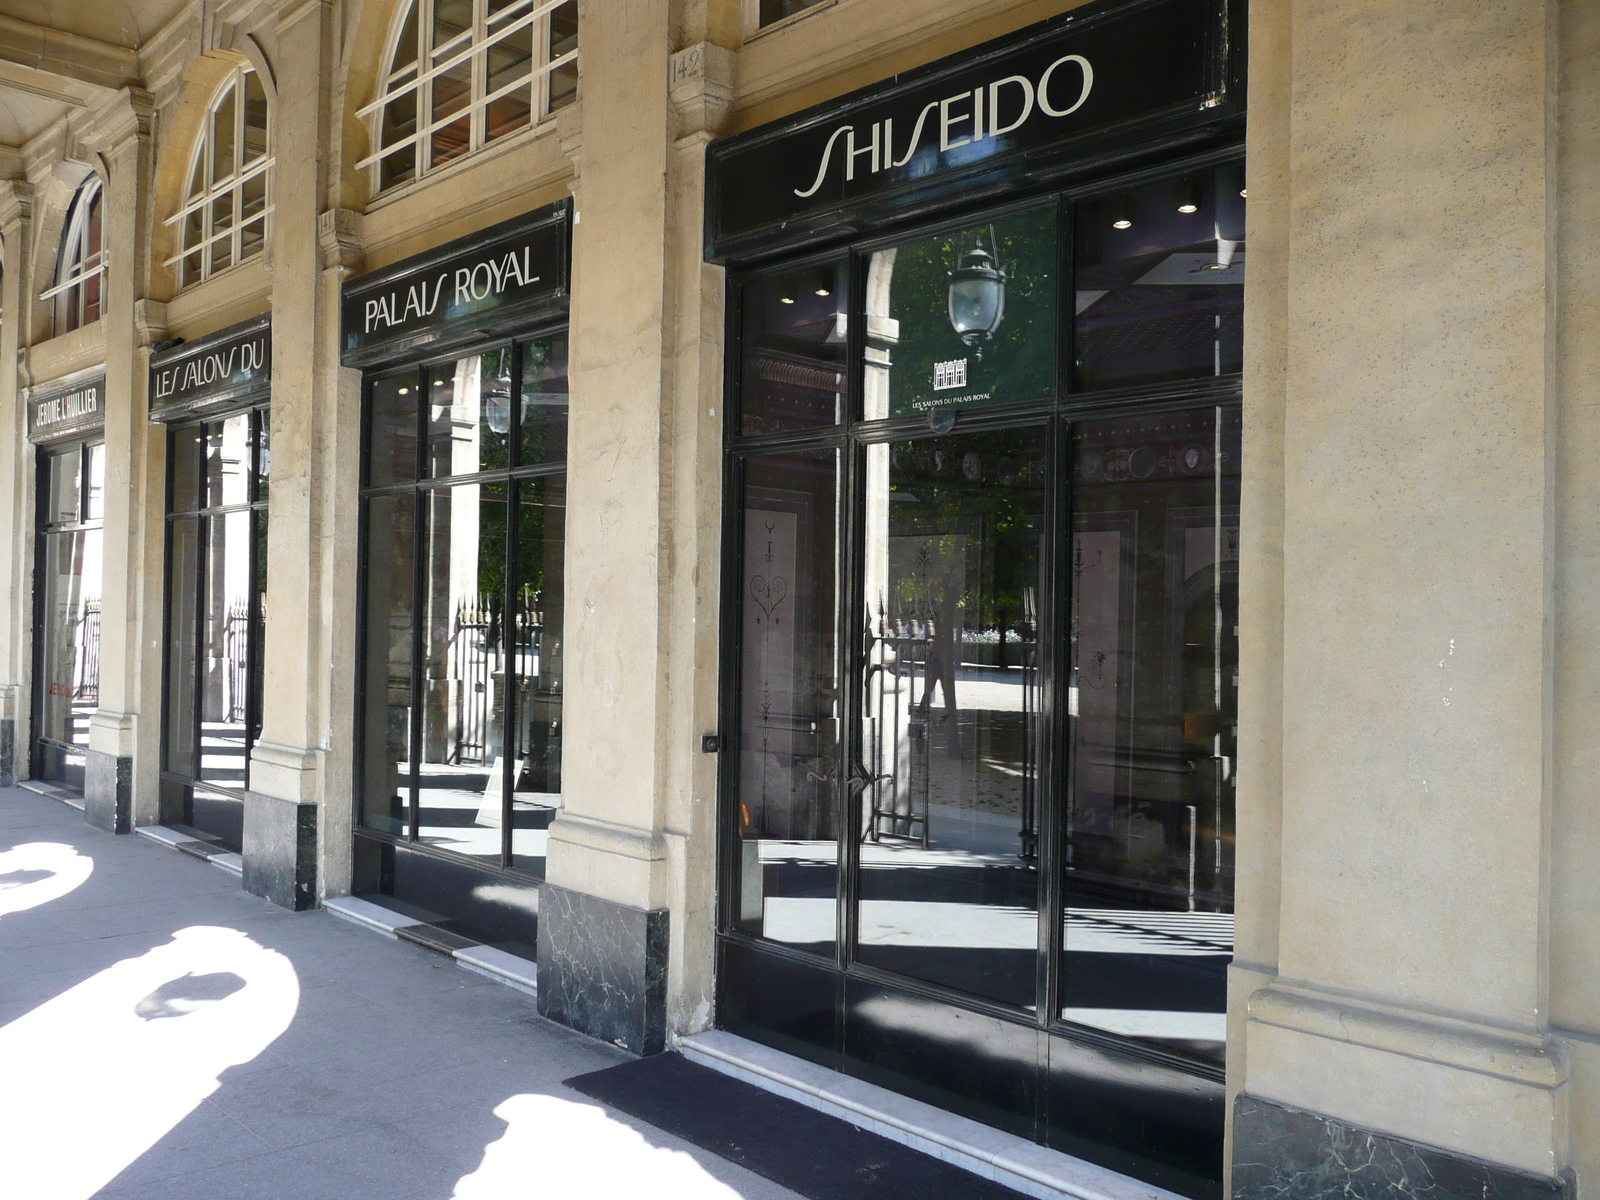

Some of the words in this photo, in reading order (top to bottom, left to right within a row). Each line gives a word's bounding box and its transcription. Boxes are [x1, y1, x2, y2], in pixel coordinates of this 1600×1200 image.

[673, 49, 699, 82] 142
[794, 54, 1094, 198] SHISEIDO
[365, 273, 447, 333] PALAIS
[455, 246, 540, 306] ROYAL
[156, 366, 180, 398] LES
[180, 346, 237, 391] SALONS
[241, 338, 264, 373] DU
[36, 398, 60, 427] JEROME
[922, 399, 943, 408] SALONS
[953, 395, 972, 403] PALAIS
[972, 393, 991, 401] ROYAL
